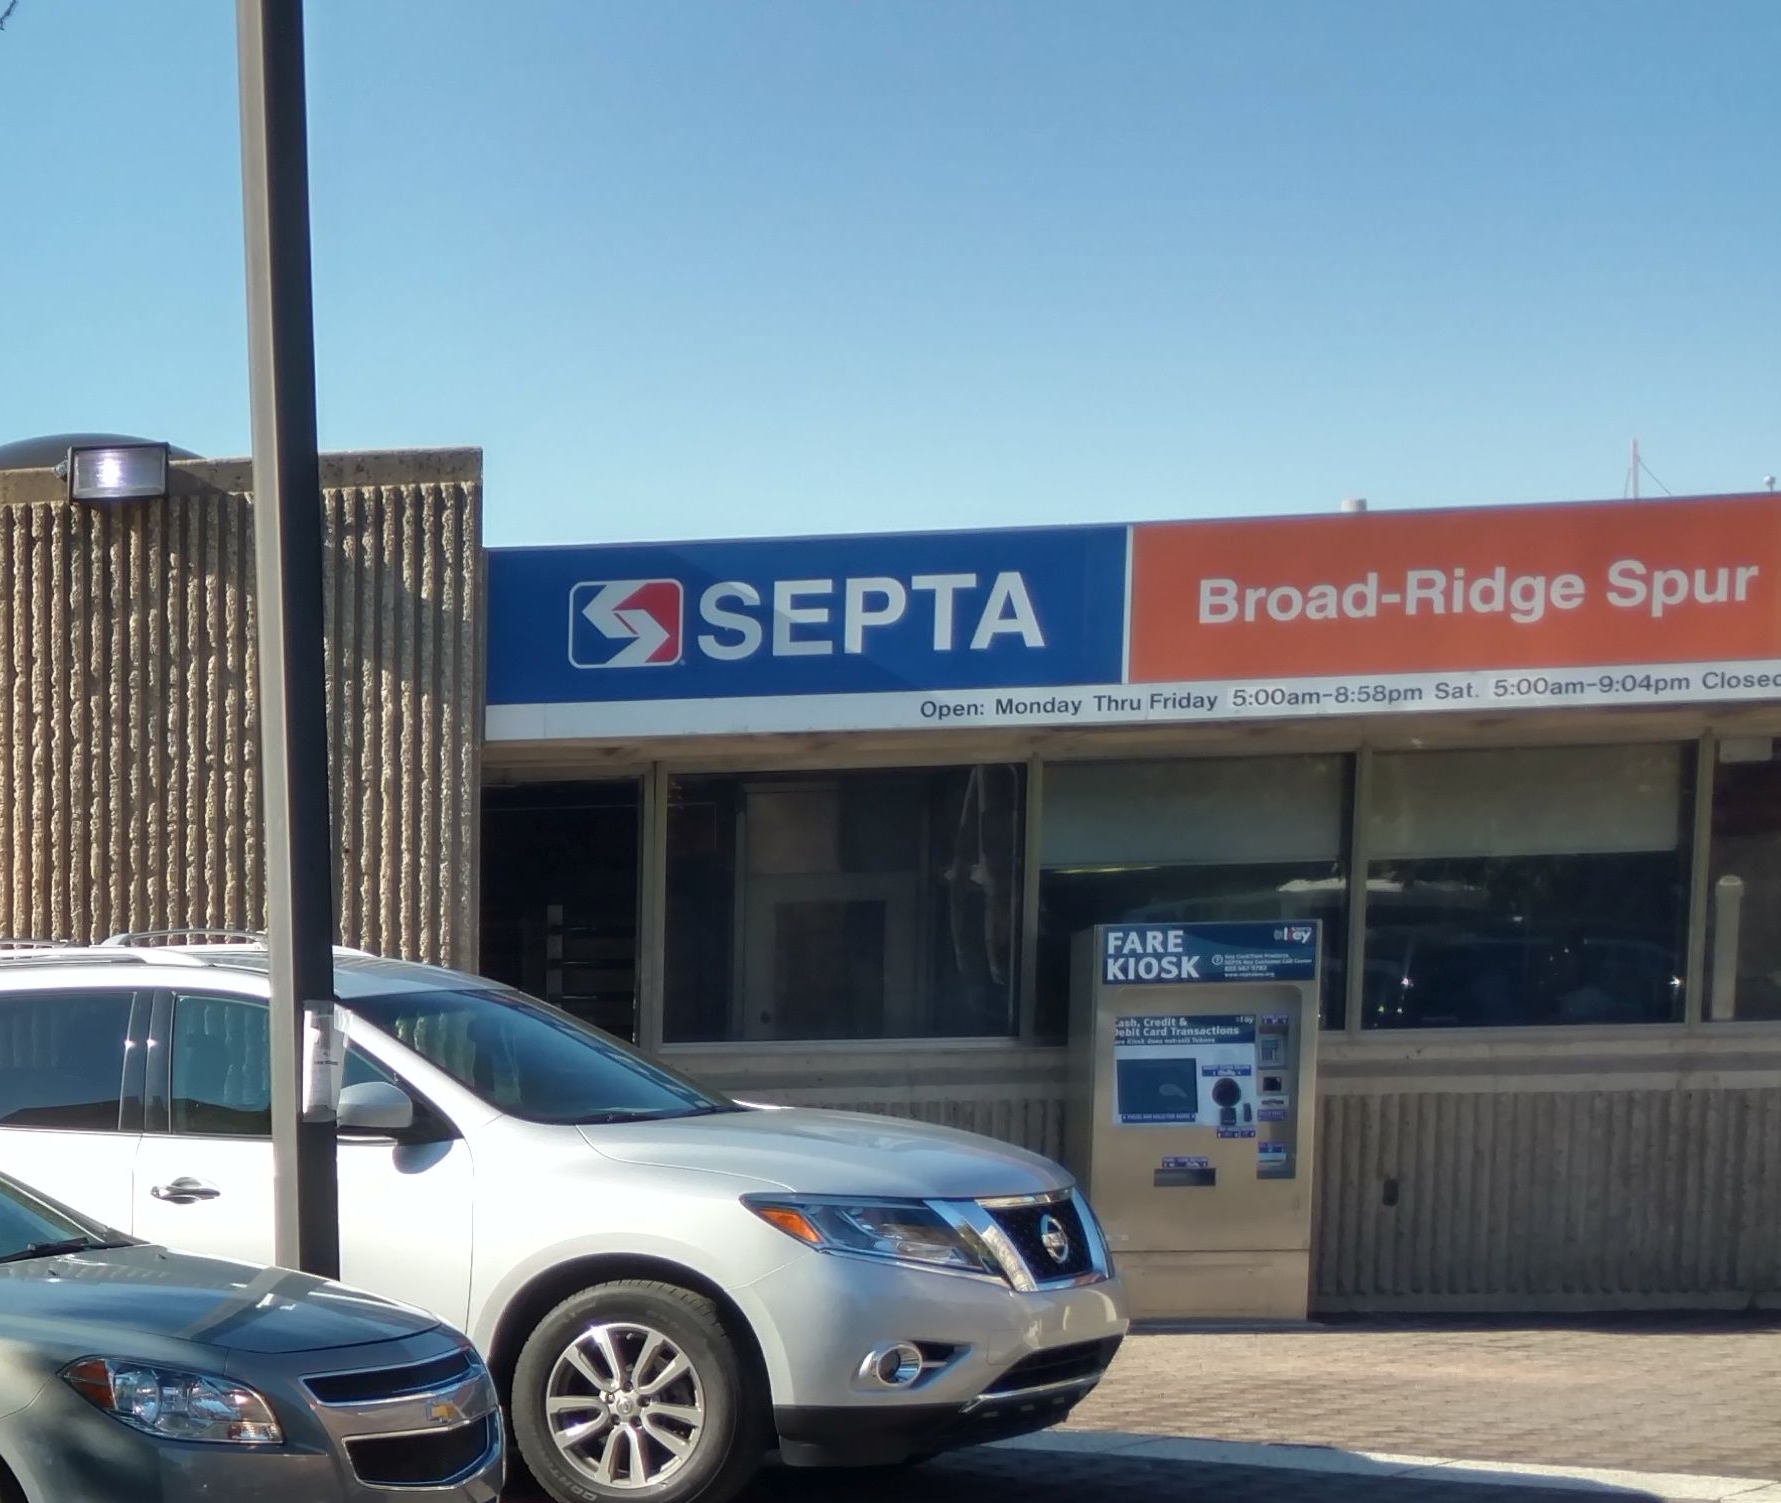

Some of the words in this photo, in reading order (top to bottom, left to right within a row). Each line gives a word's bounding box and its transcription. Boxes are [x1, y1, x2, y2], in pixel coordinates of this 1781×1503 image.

[1198, 566, 1586, 624] Broad-Ridge
[1606, 558, 1759, 619] Spur
[697, 570, 1046, 662] SEPTA
[920, 700, 985, 721] Open:
[995, 695, 1083, 717] Monday
[1093, 694, 1142, 713] Thru
[1149, 691, 1218, 712] Friday
[1231, 684, 1423, 708] 5:00am-8:58pm
[1434, 681, 1480, 701] Sat.
[1493, 674, 1691, 698] 5:00am-9:04pm
[1106, 930, 1184, 954] FARE
[1106, 955, 1201, 981] KIOSK
[1143, 1017, 1176, 1027] Credit
[1179, 1018, 1188, 1026] &
[1143, 1027, 1167, 1036] Card
[1170, 1026, 1240, 1037] Transactions
